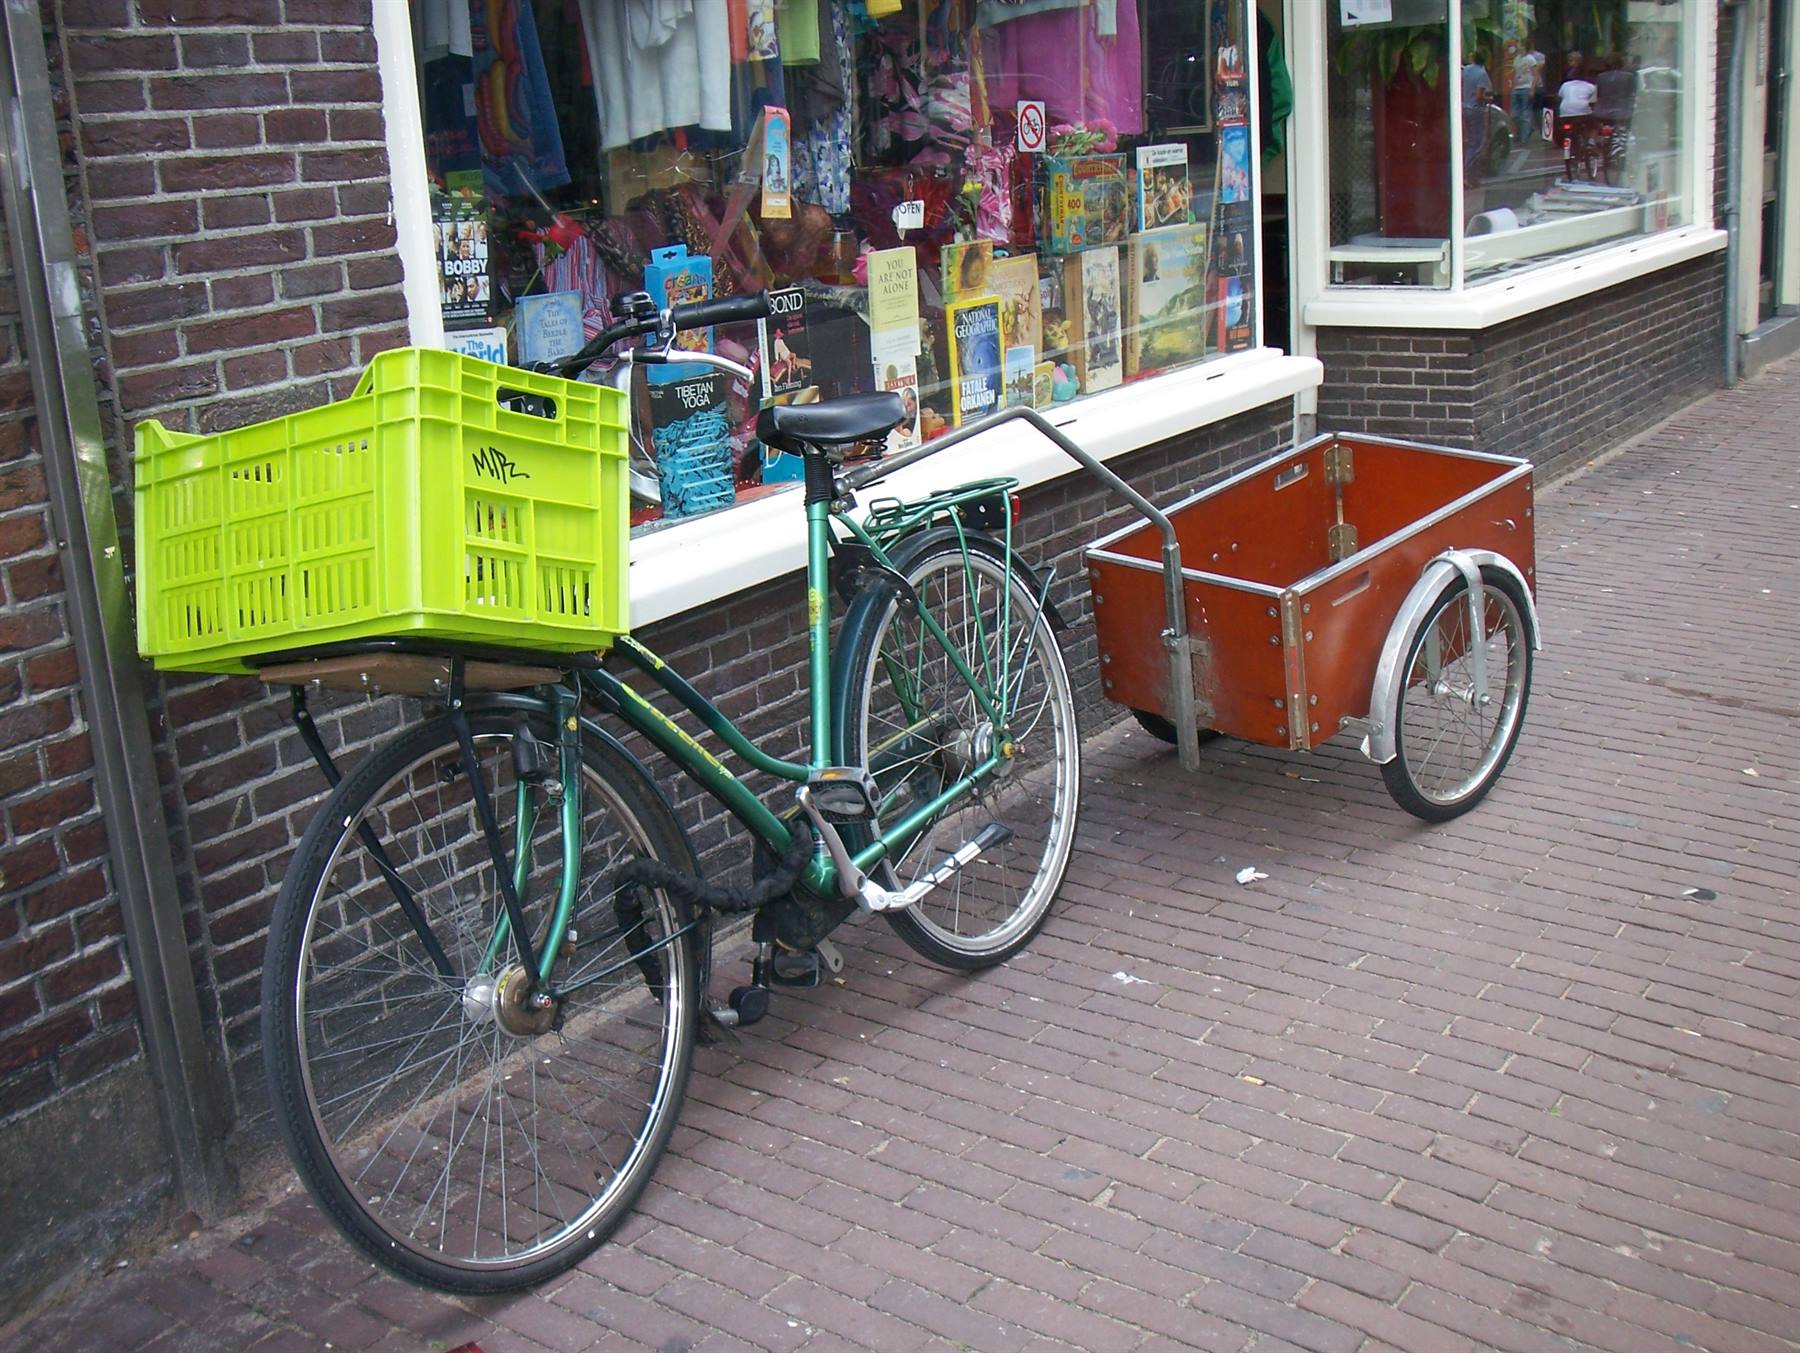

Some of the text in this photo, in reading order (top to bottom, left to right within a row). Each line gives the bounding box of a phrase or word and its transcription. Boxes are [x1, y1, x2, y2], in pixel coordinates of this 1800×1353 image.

[899, 204, 920, 214] OPEN
[444, 259, 488, 276] BOBBY
[887, 259, 903, 271] YOU
[879, 268, 913, 284] ARE NOT
[883, 281, 909, 295] ALONE
[770, 293, 803, 315] BOND
[962, 308, 992, 326] NATIONAL
[955, 318, 997, 338] GEOGRAPHIC
[466, 339, 484, 351] The
[675, 381, 714, 399] TIBETAN
[961, 376, 988, 398] FATALE
[682, 394, 711, 409] YOGA
[961, 389, 995, 412] ORKANEN
